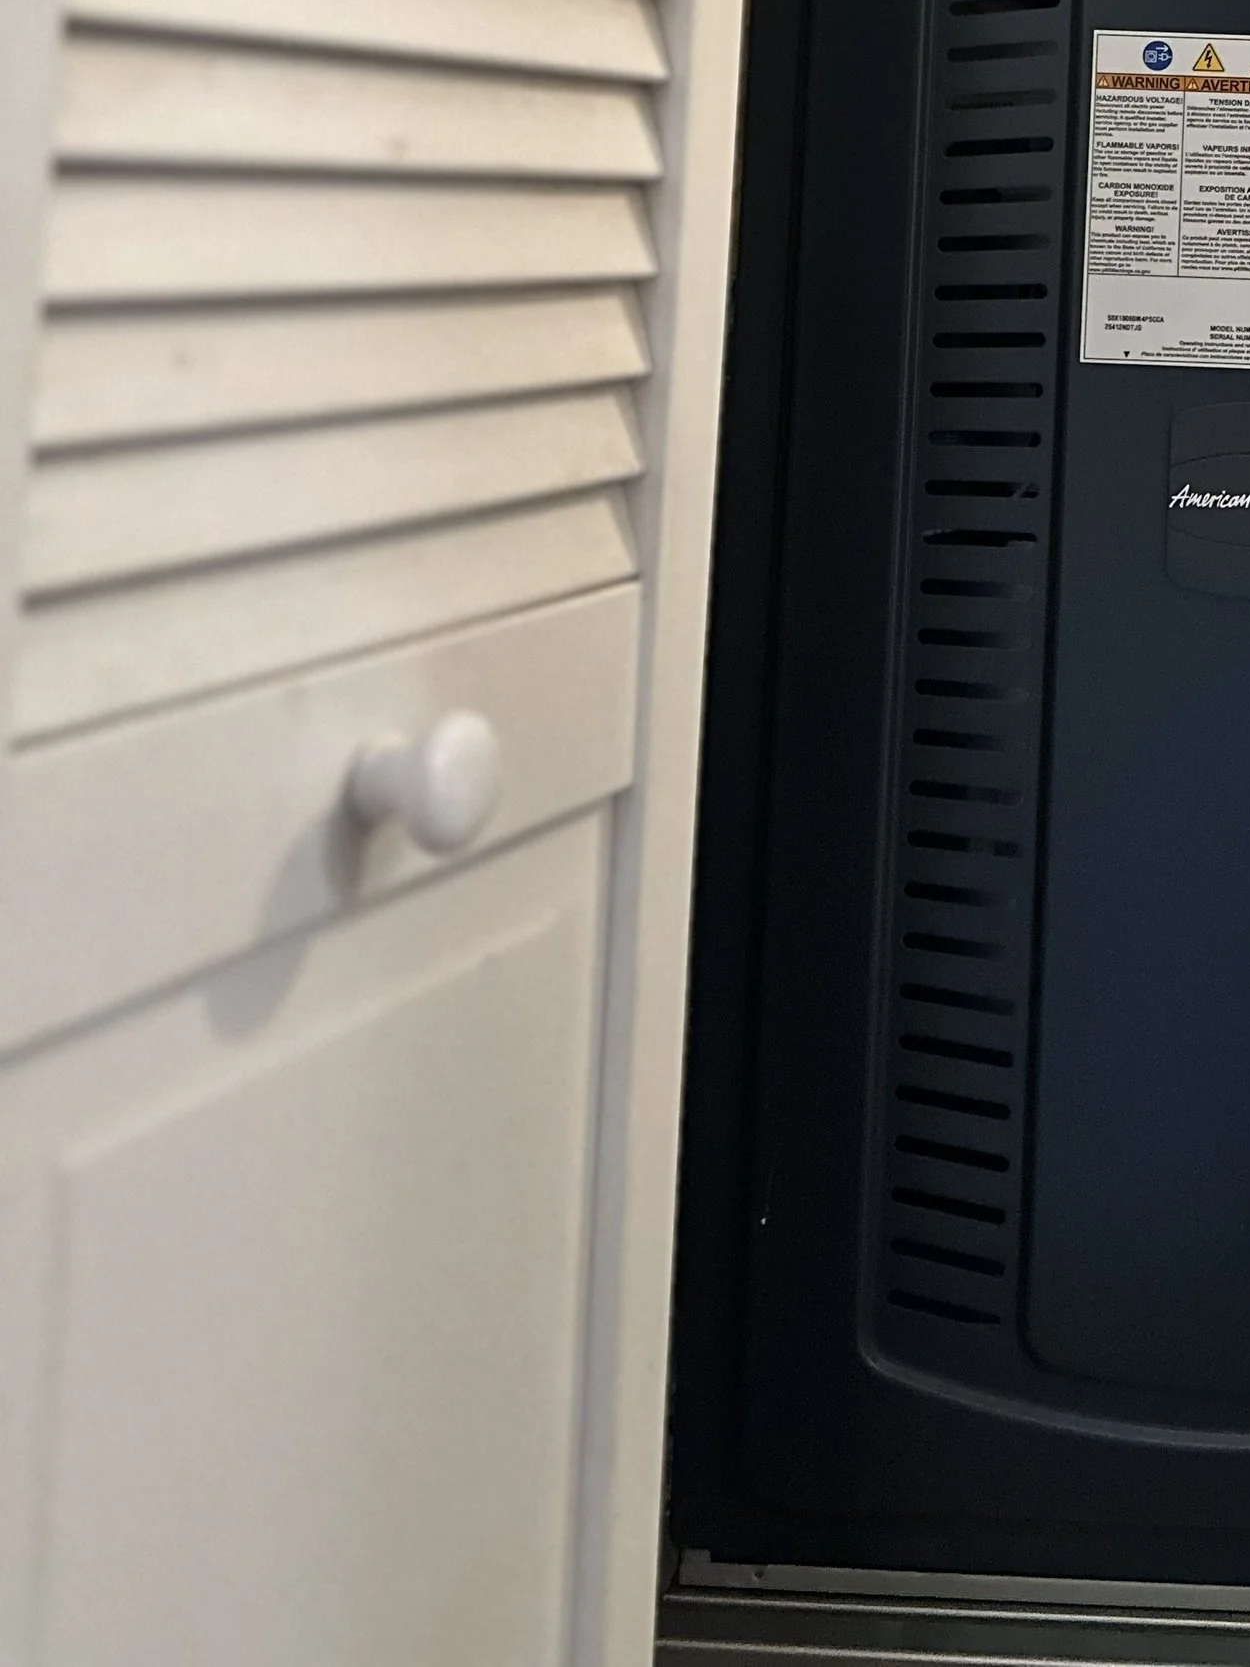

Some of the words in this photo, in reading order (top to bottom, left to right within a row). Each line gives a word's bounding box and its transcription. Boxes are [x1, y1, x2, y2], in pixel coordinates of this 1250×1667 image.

[1111, 74, 1180, 89] WARNING
[1095, 94, 1144, 102] HAZARDOUS
[1145, 96, 1182, 104] VOLTAGE!
[1209, 98, 1242, 106] TENSION
[1096, 141, 1143, 149] FLAMMABLE
[1145, 142, 1179, 150] VAPORS!
[1202, 144, 1238, 152] VAPEURS
[1098, 181, 1131, 189] CARBON
[1133, 182, 1174, 191] MONOXIDE
[1199, 185, 1245, 193] EXPOSITION
[1113, 189, 1158, 198] EXPOSURE!
[1114, 224, 1153, 232] WARNING!
[1107, 314, 1164, 322] S8X1B080M4PSCCA
